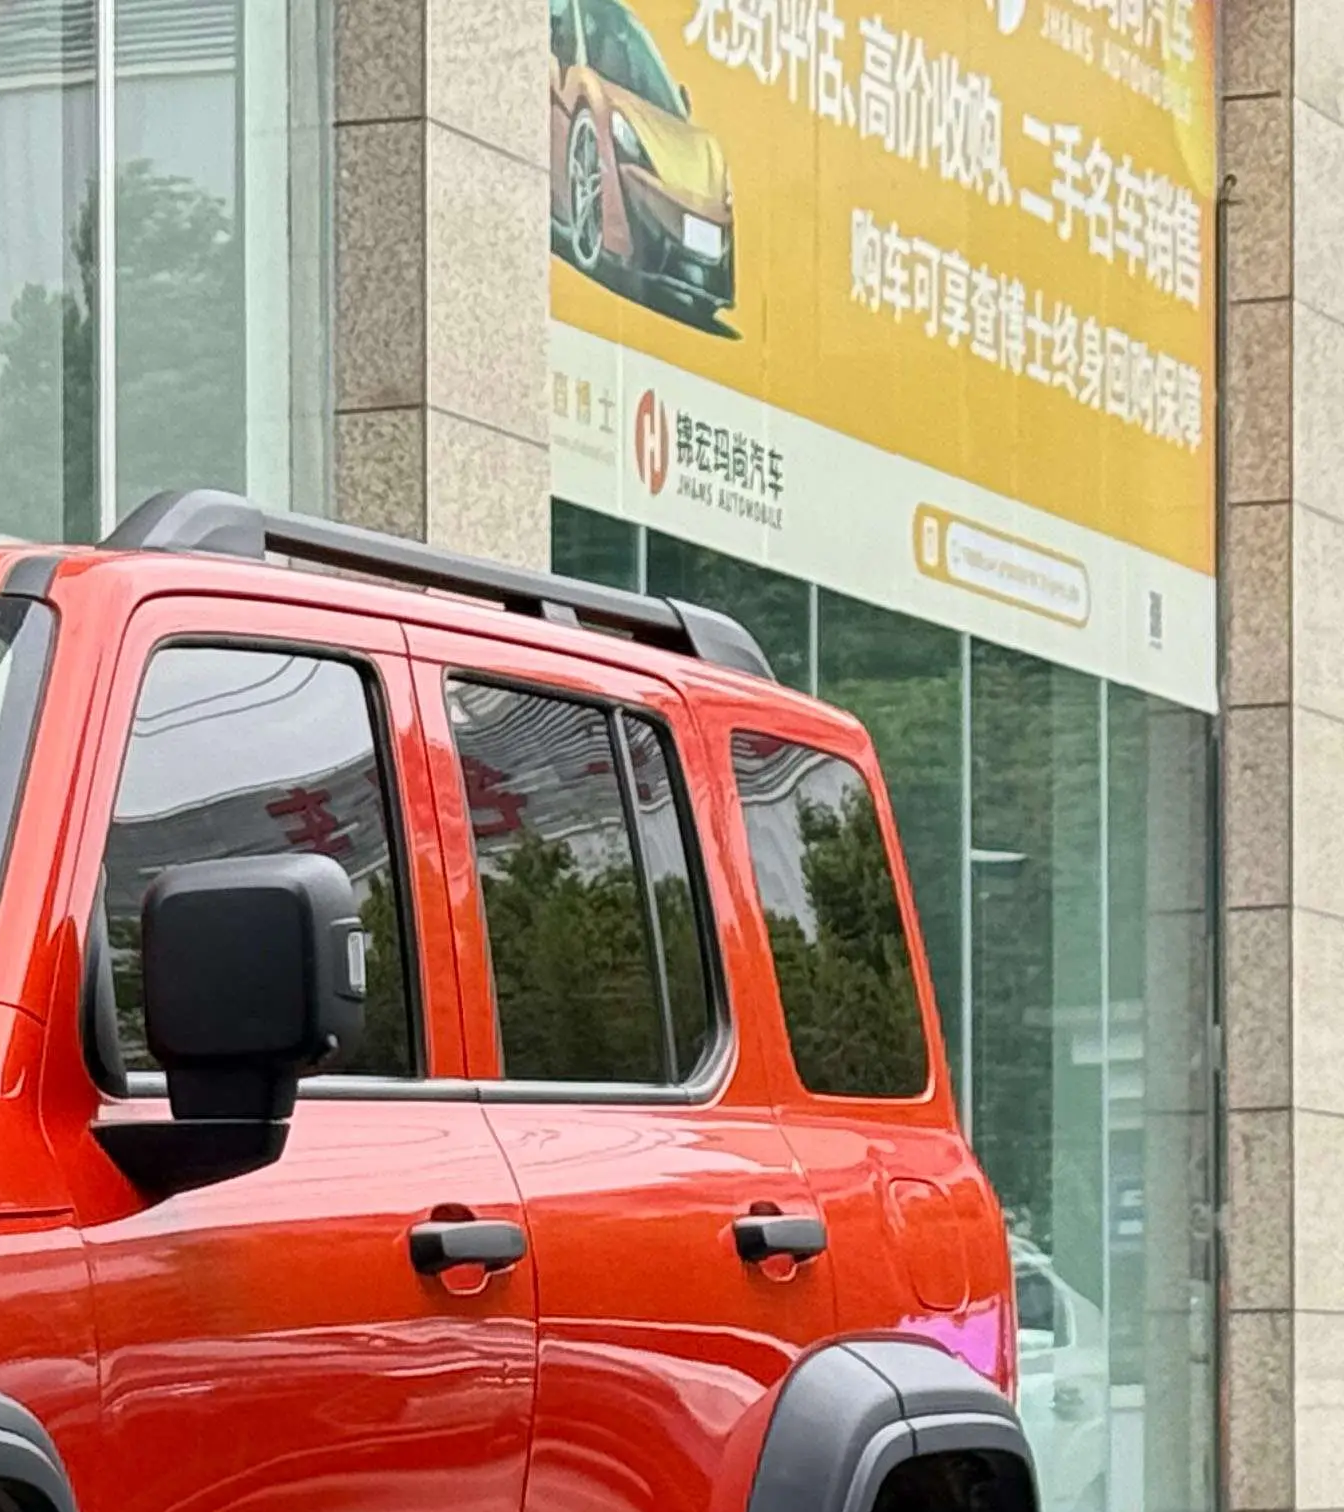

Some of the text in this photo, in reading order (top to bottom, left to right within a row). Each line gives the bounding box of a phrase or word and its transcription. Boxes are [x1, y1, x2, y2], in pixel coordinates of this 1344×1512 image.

[850, 207, 1203, 453] 购车可享查博士终身回购保障
